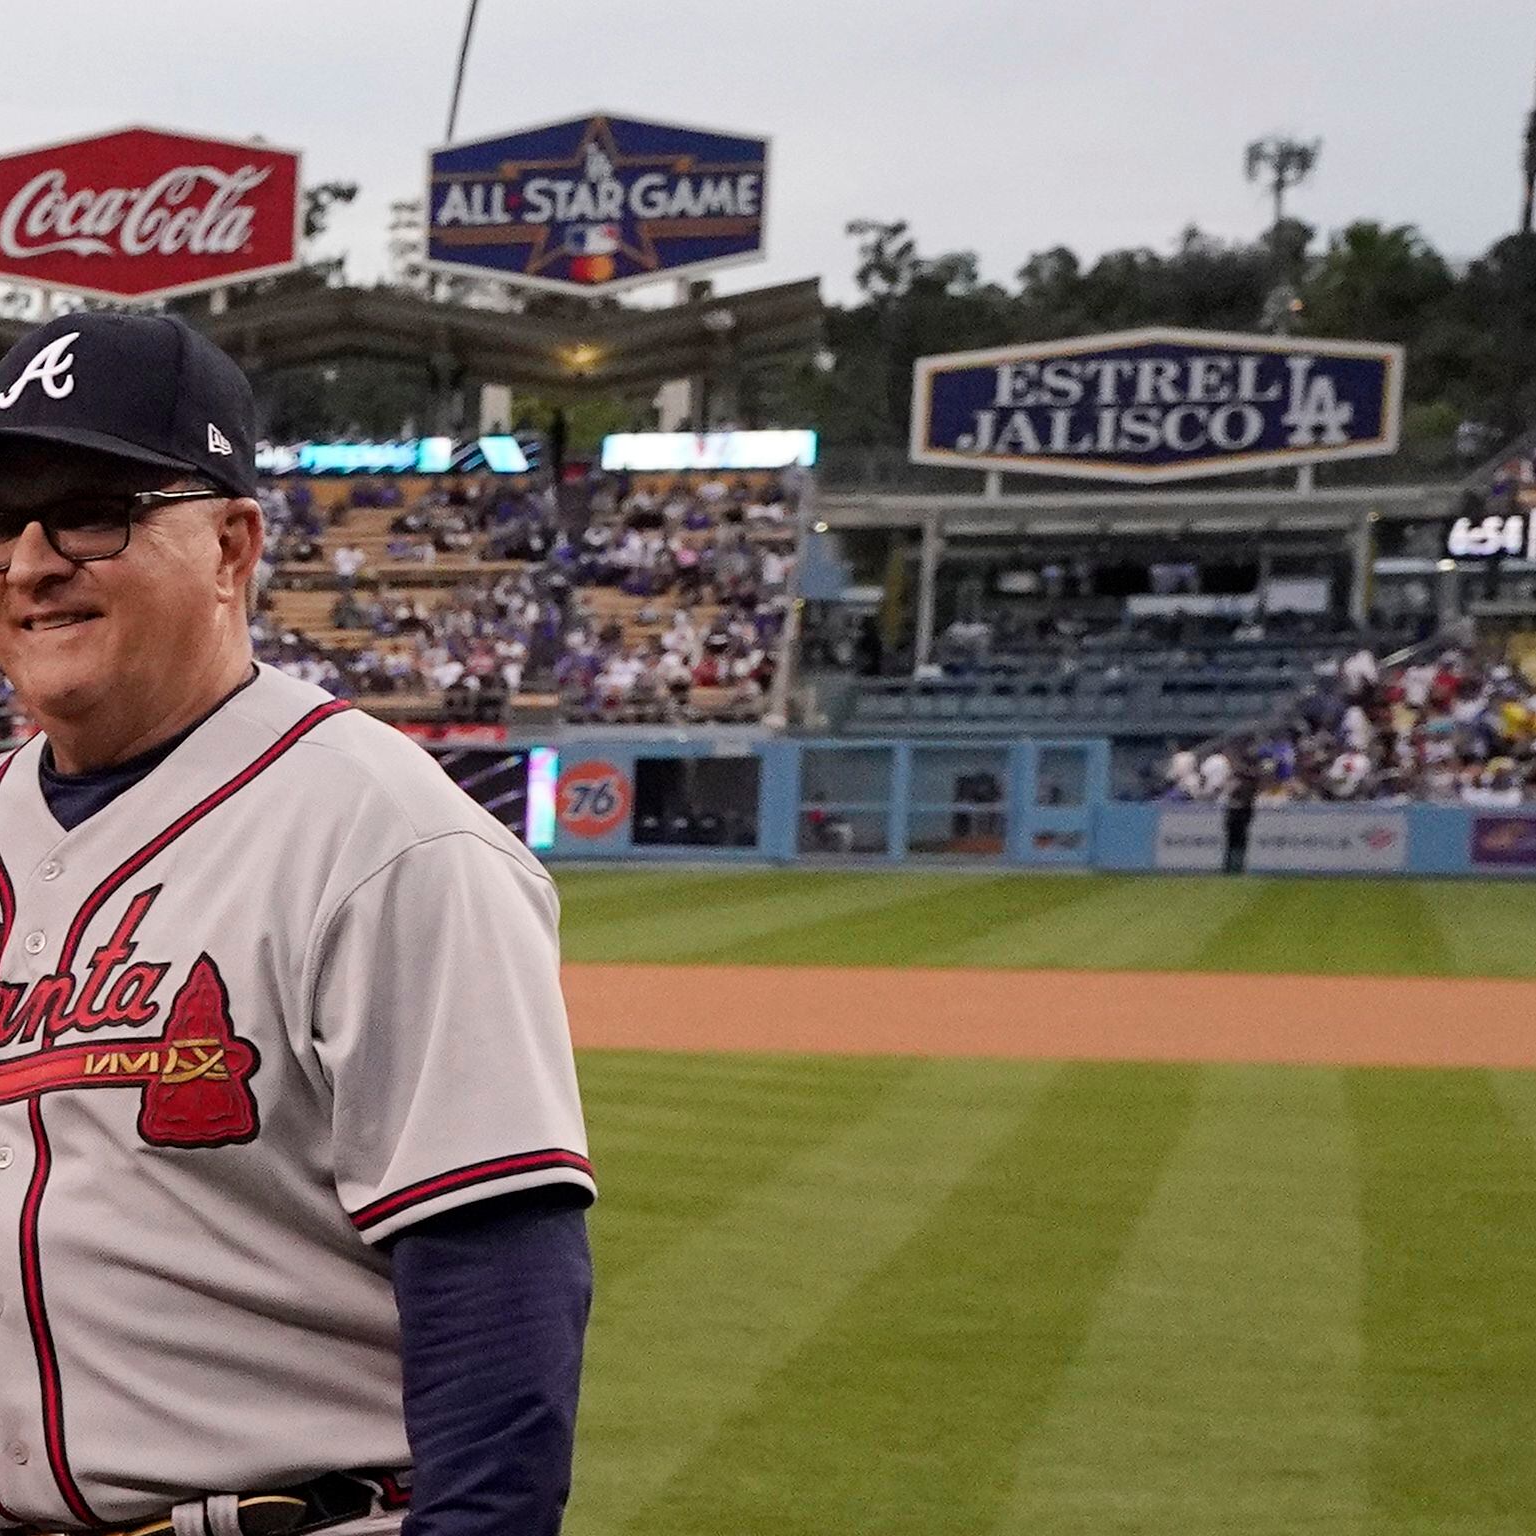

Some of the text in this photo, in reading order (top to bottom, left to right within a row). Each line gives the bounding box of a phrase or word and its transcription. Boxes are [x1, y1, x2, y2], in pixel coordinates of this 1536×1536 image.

[436, 172, 761, 226] ALL STAR GAME
[955, 404, 1265, 454] JALISCO
[567, 782, 617, 816] 76
